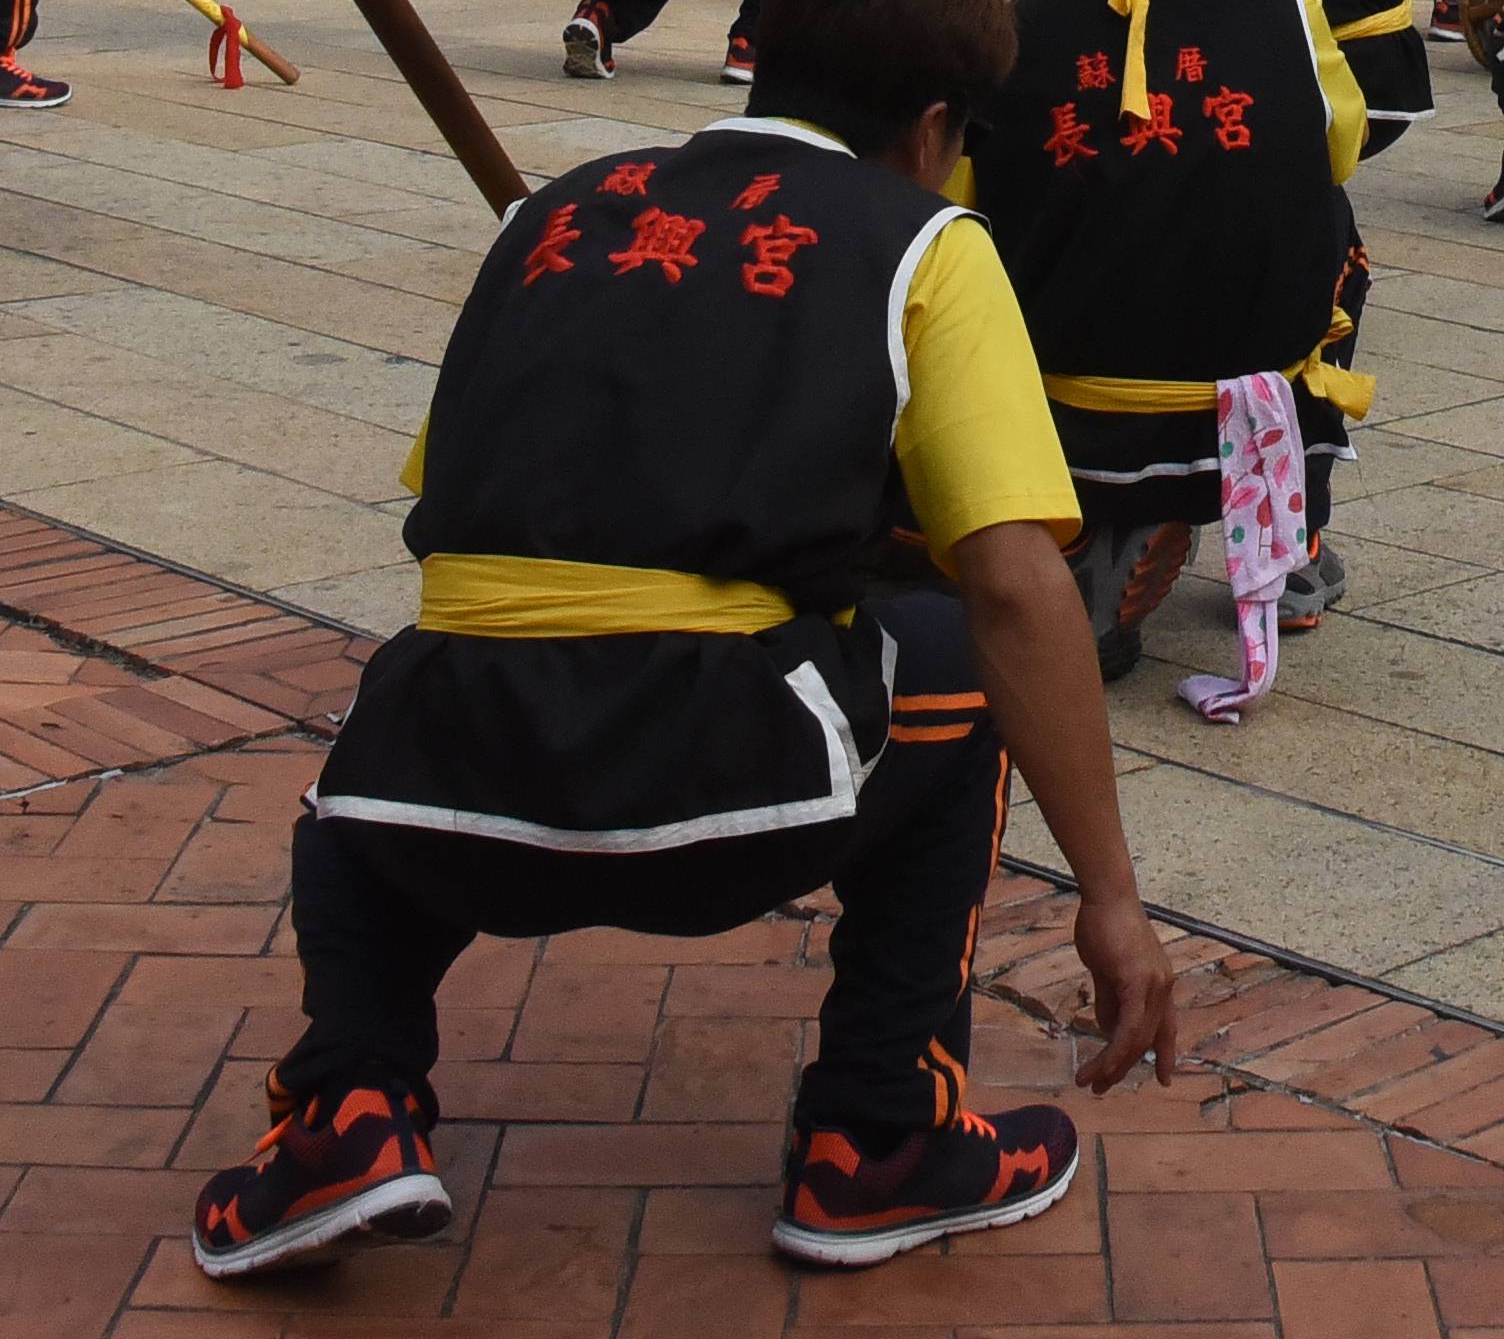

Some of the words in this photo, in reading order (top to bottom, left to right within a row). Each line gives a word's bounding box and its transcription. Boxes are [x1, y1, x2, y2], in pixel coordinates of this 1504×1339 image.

[1043, 85, 1254, 167] 長興宮
[522, 203, 818, 299] 長興宮
